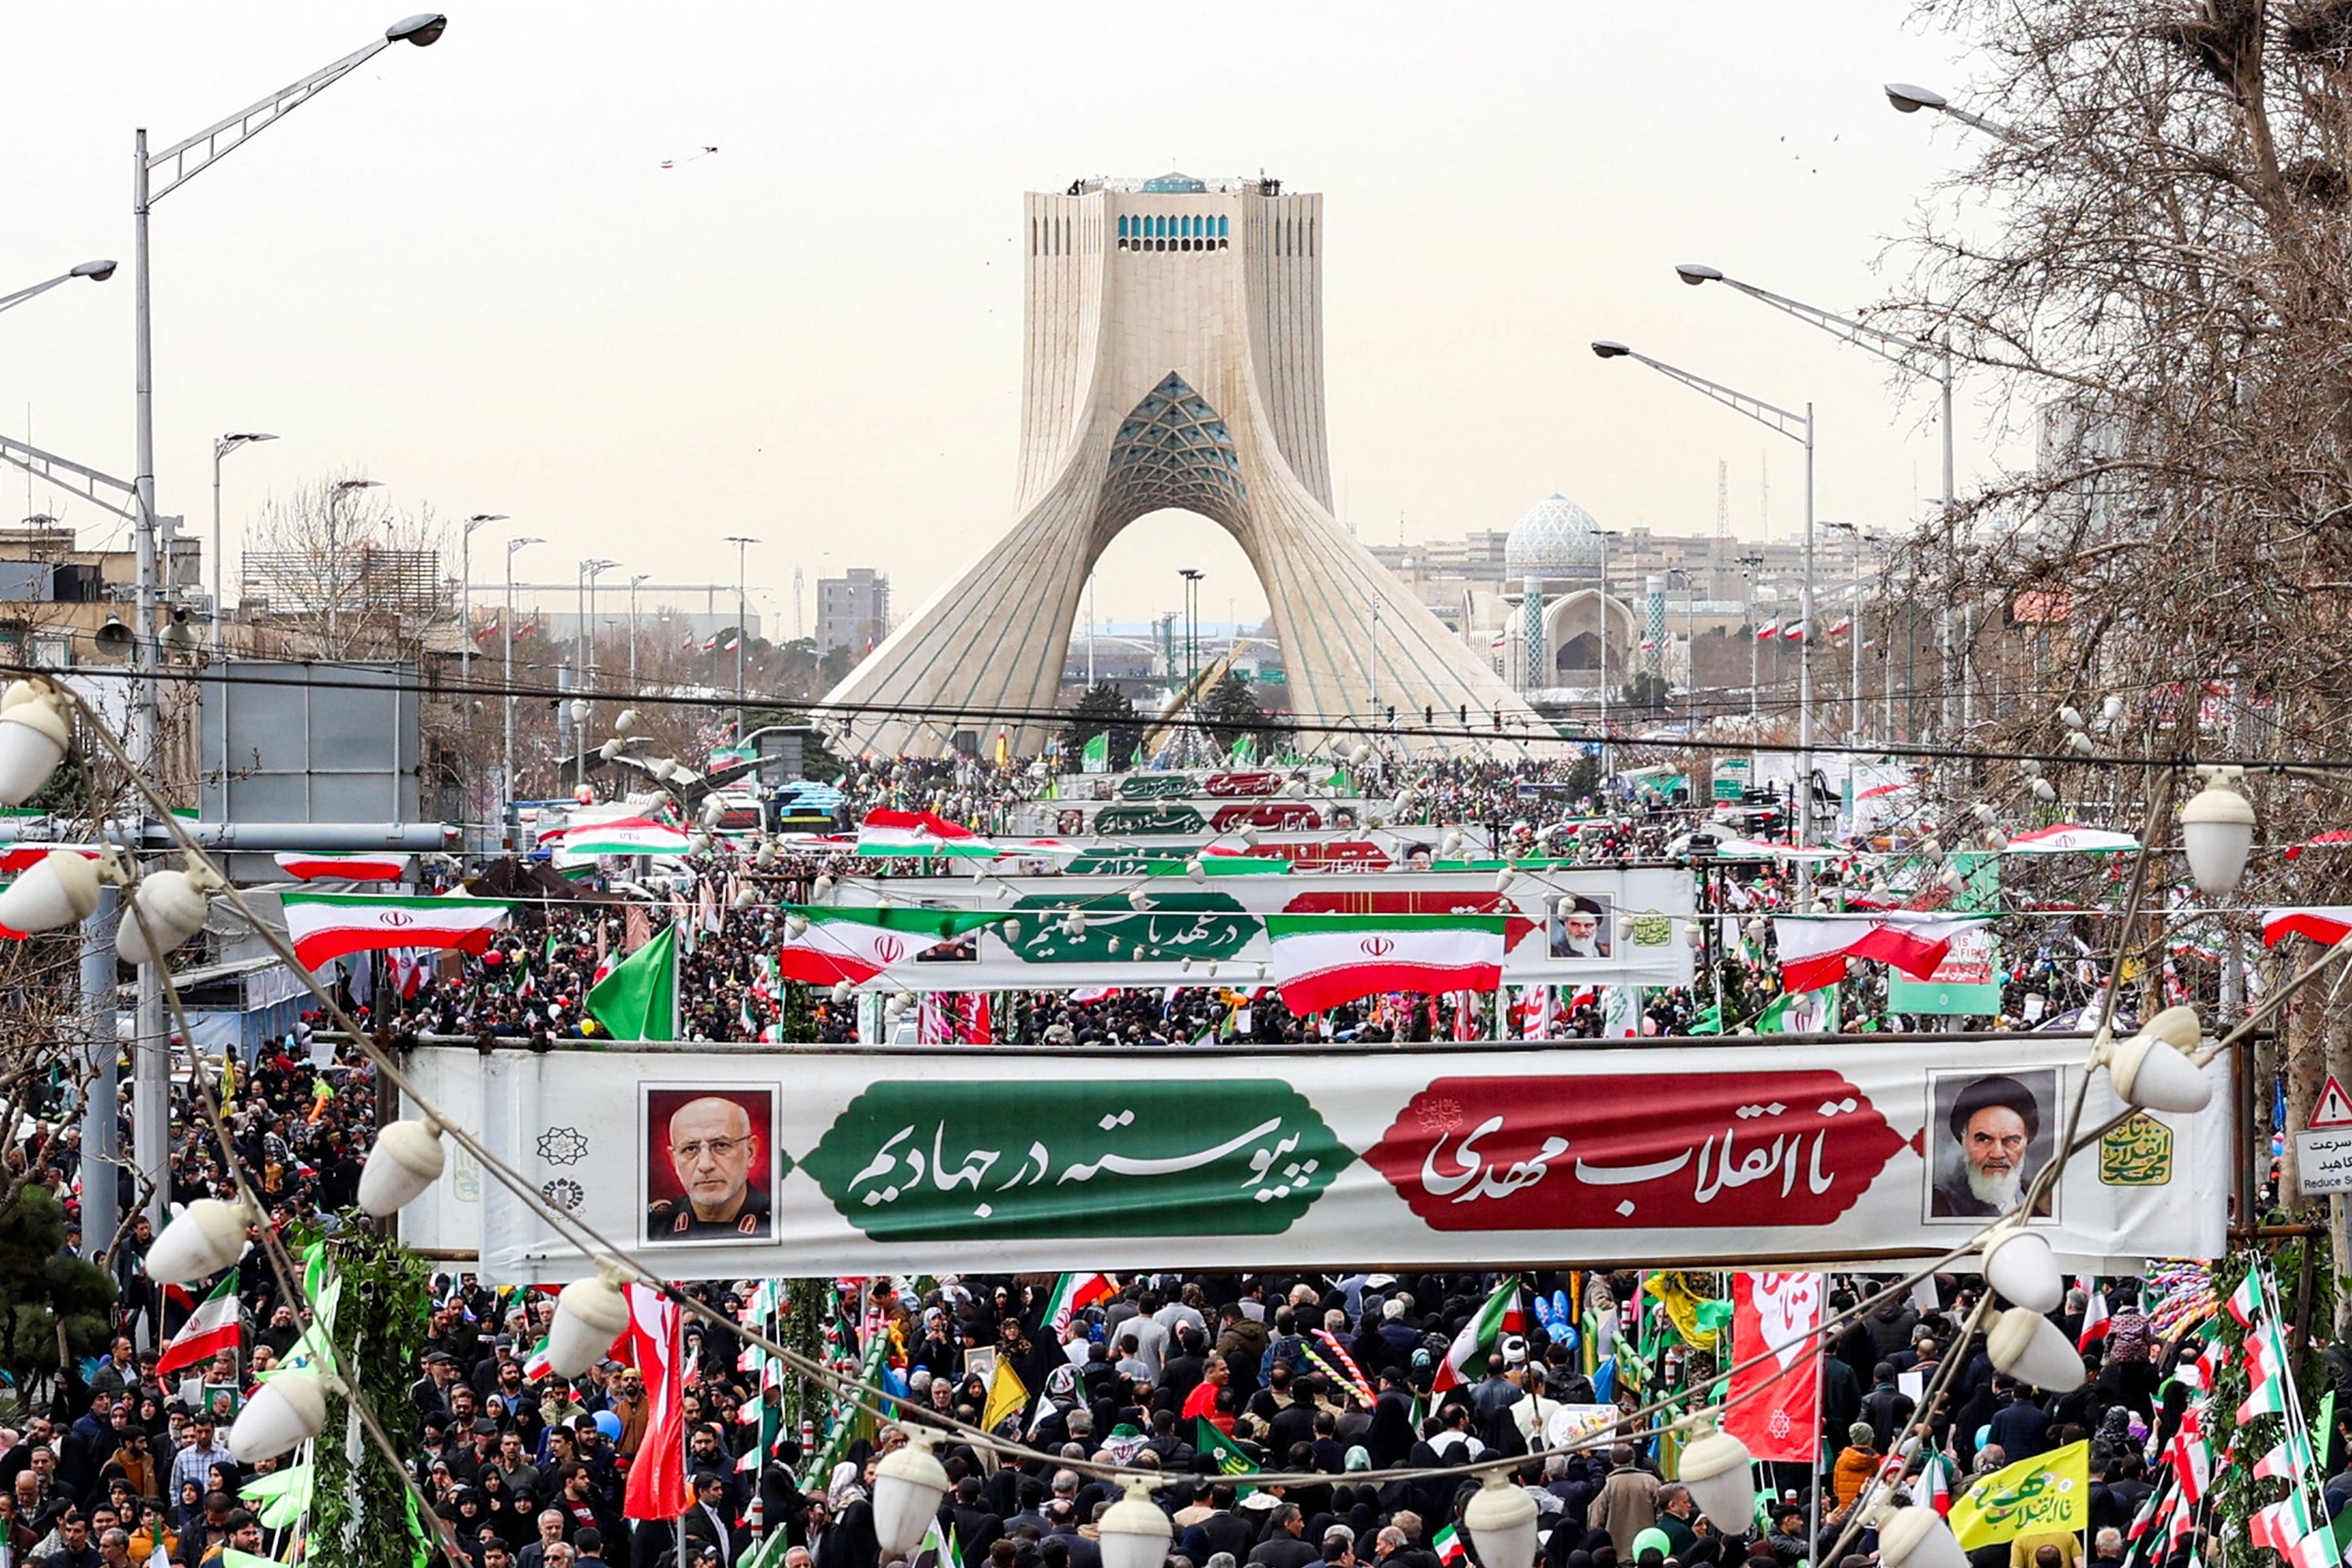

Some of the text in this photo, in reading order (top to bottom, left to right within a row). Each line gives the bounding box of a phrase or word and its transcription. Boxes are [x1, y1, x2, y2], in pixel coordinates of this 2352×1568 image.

[847, 1109, 1318, 1219] پیوسته در جهادیم
[1420, 1098, 1857, 1217] تا انقلاب مهدی
[2309, 1139, 2352, 1153] سرعت
[2304, 1175, 2352, 1188] Reduce S
